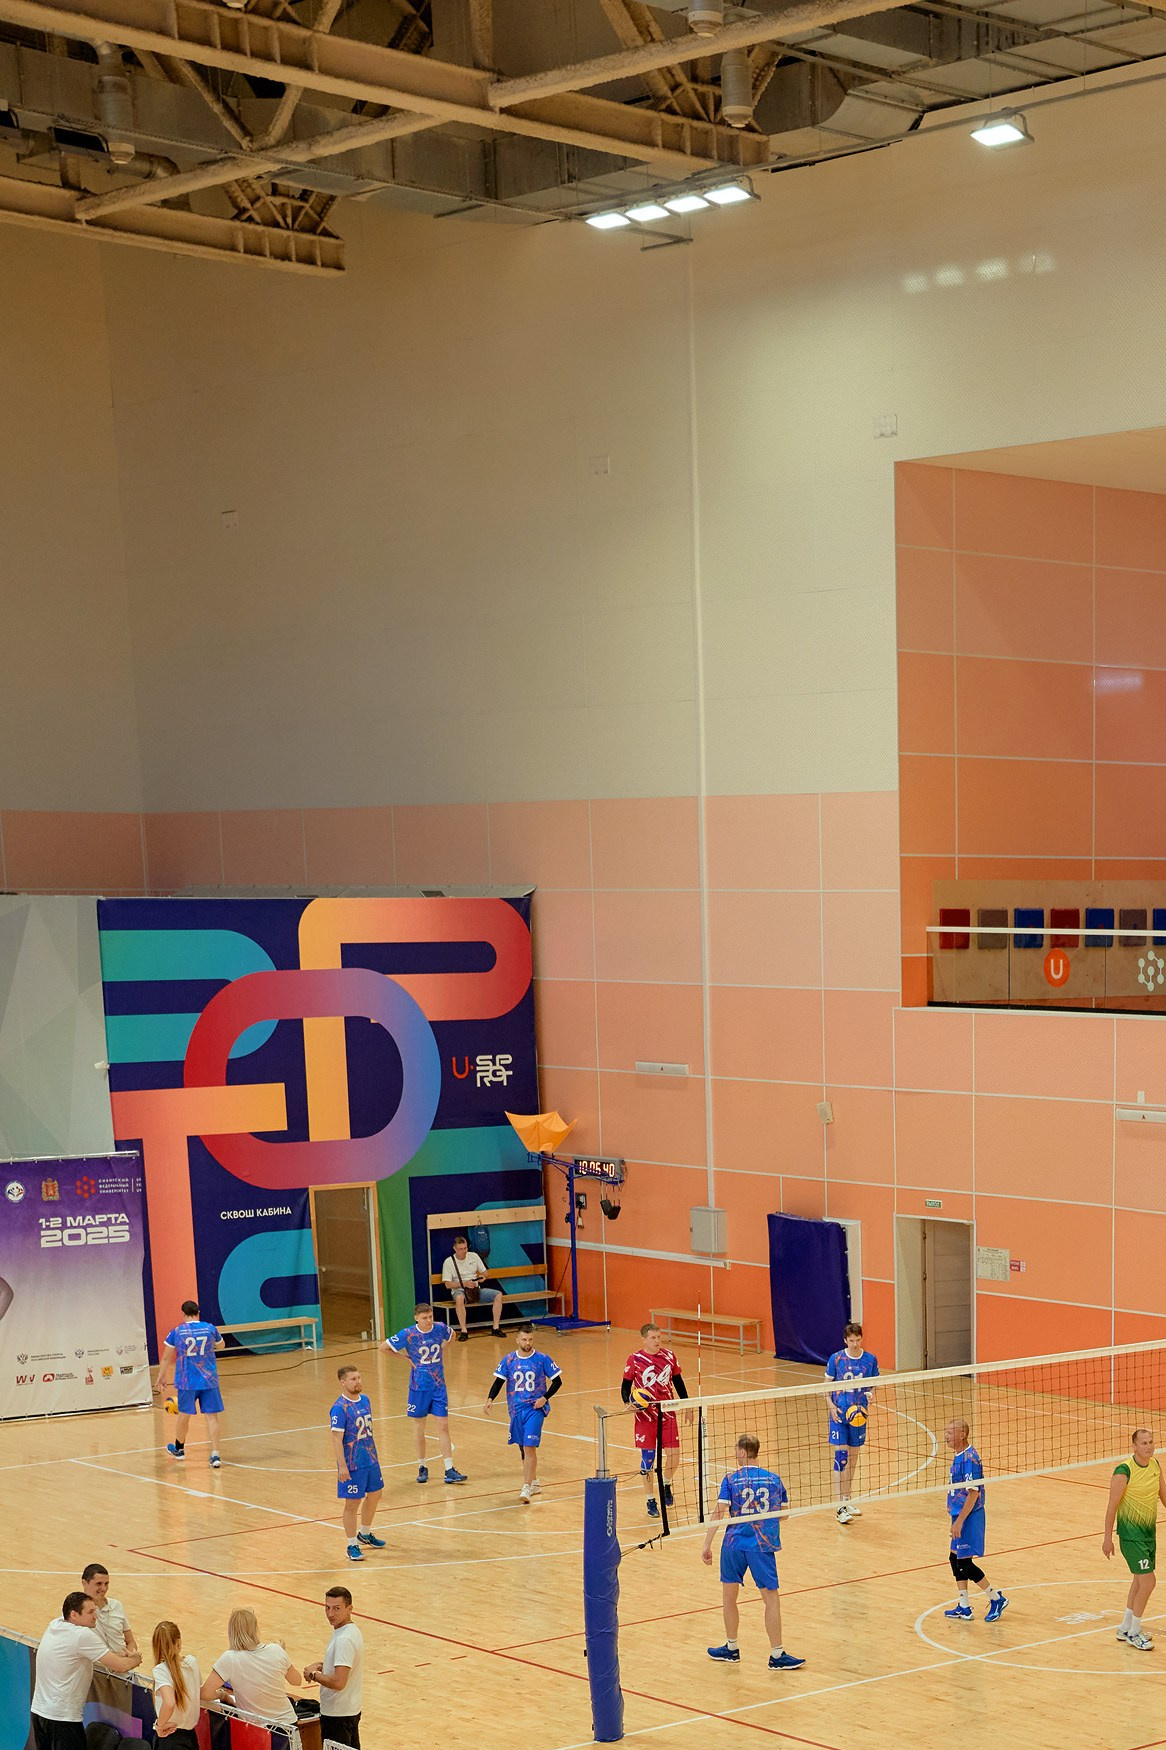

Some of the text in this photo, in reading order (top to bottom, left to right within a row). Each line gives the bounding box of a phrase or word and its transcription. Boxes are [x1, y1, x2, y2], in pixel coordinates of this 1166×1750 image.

[39, 1213, 129, 1229] 1-2 МАРТА
[220, 1206, 292, 1220] СКВОШ КАБИНА
[40, 1225, 130, 1248] 2025
[185, 1336, 208, 1357] 27
[418, 1344, 441, 1365] 22
[513, 1371, 536, 1392] 28
[406, 1403, 417, 1413] 22
[355, 1413, 373, 1440] 25
[831, 1430, 839, 1440] 21
[741, 1487, 770, 1514] 23
[1138, 1558, 1150, 1570] 12
